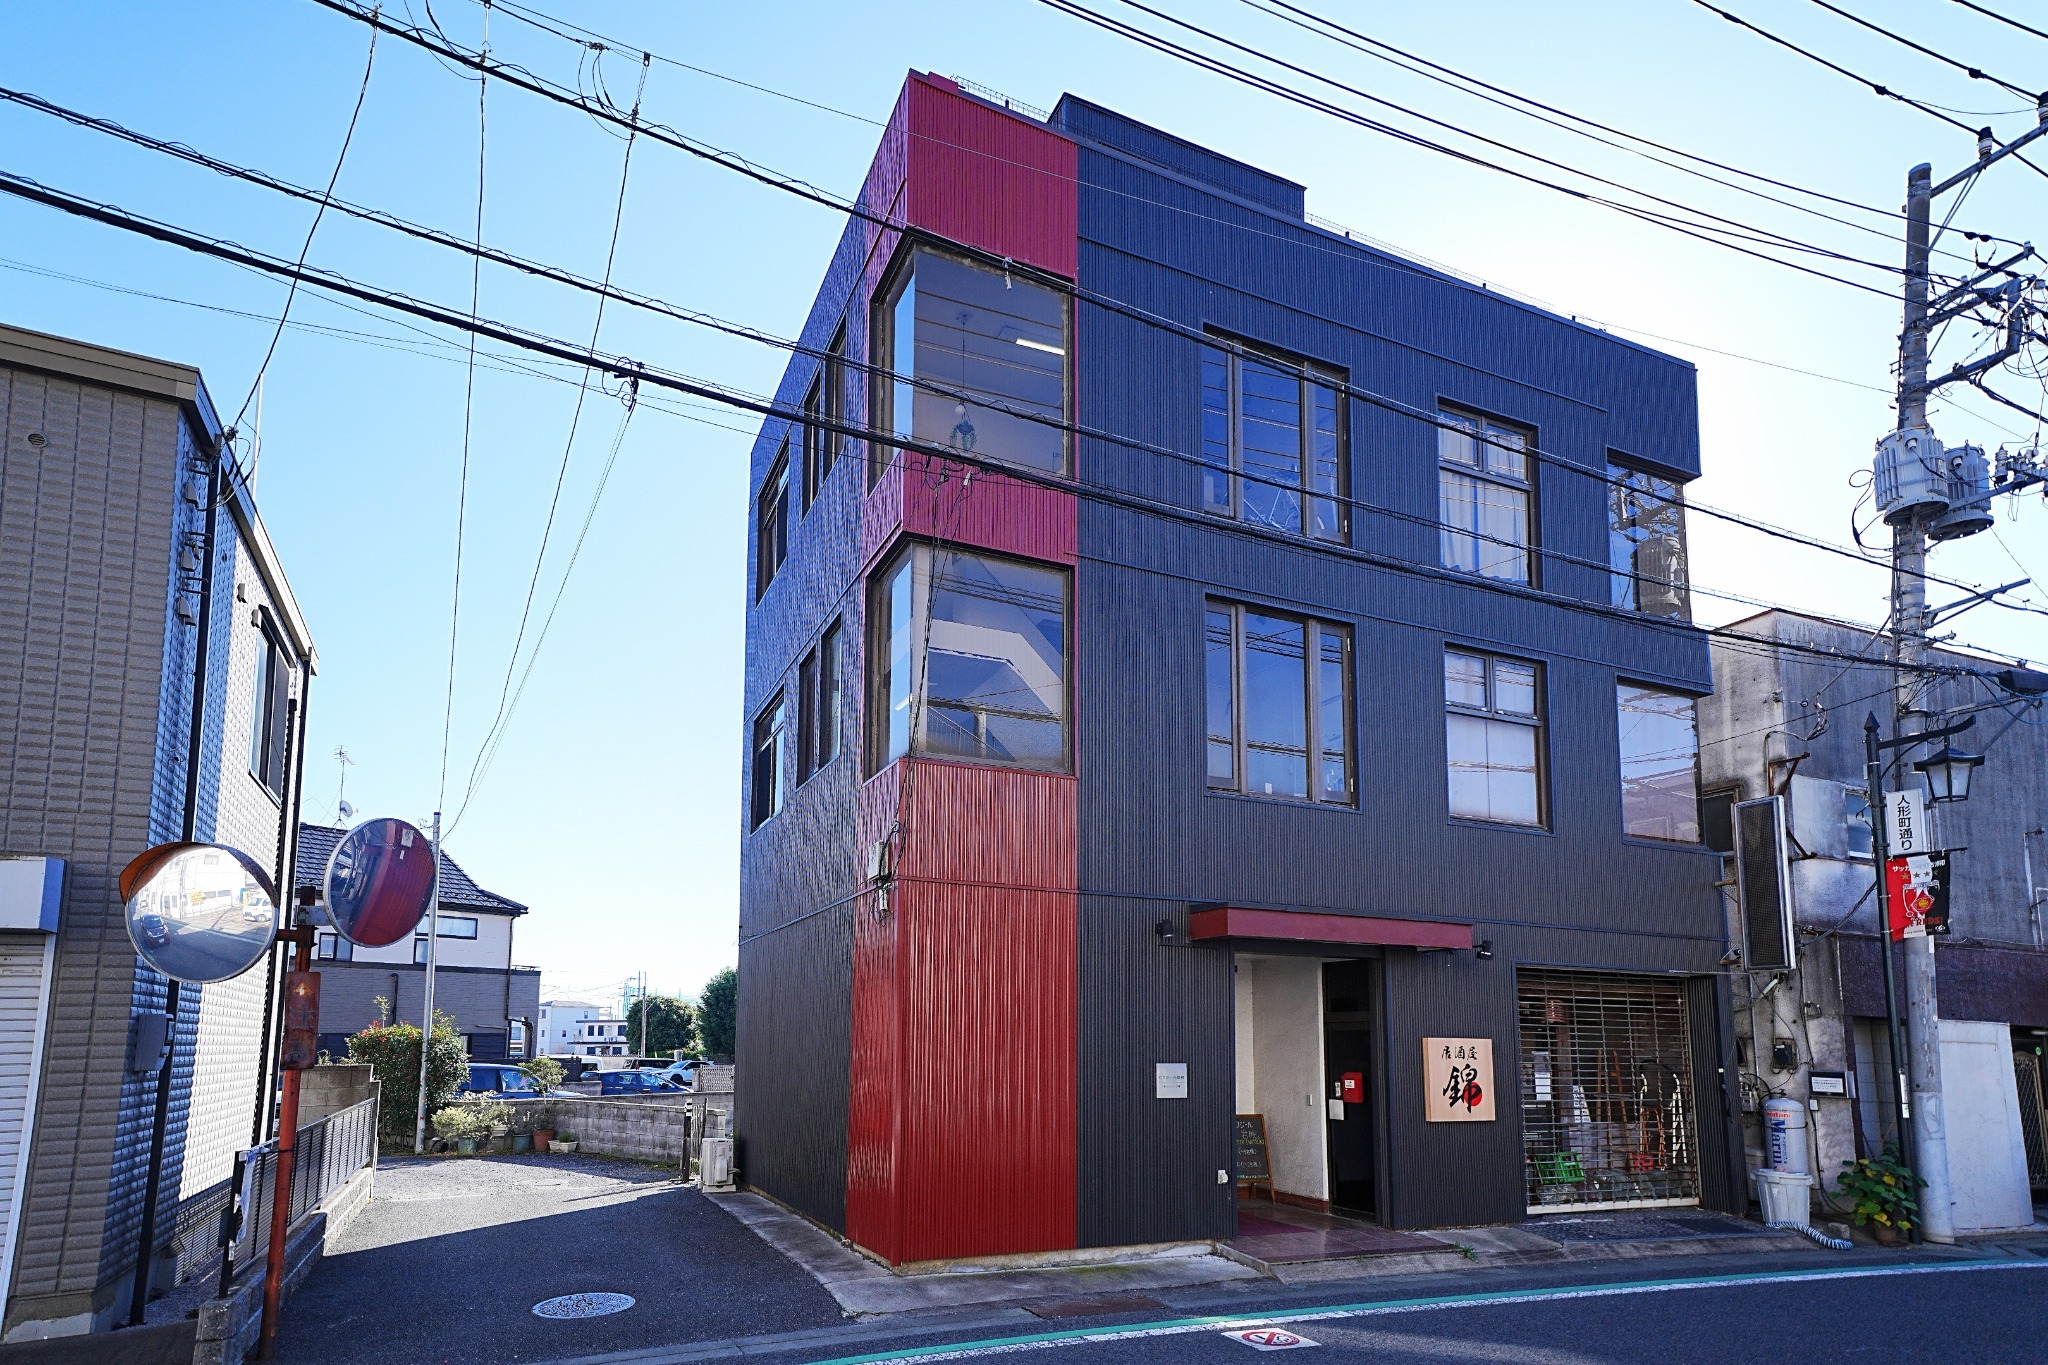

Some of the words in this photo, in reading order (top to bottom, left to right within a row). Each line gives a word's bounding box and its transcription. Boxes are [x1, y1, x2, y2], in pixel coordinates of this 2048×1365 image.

[1897, 795, 1913, 850] 人形町通り
[1442, 1045, 1477, 1060] 居酒屋
[1443, 1063, 1482, 1113] 錦
